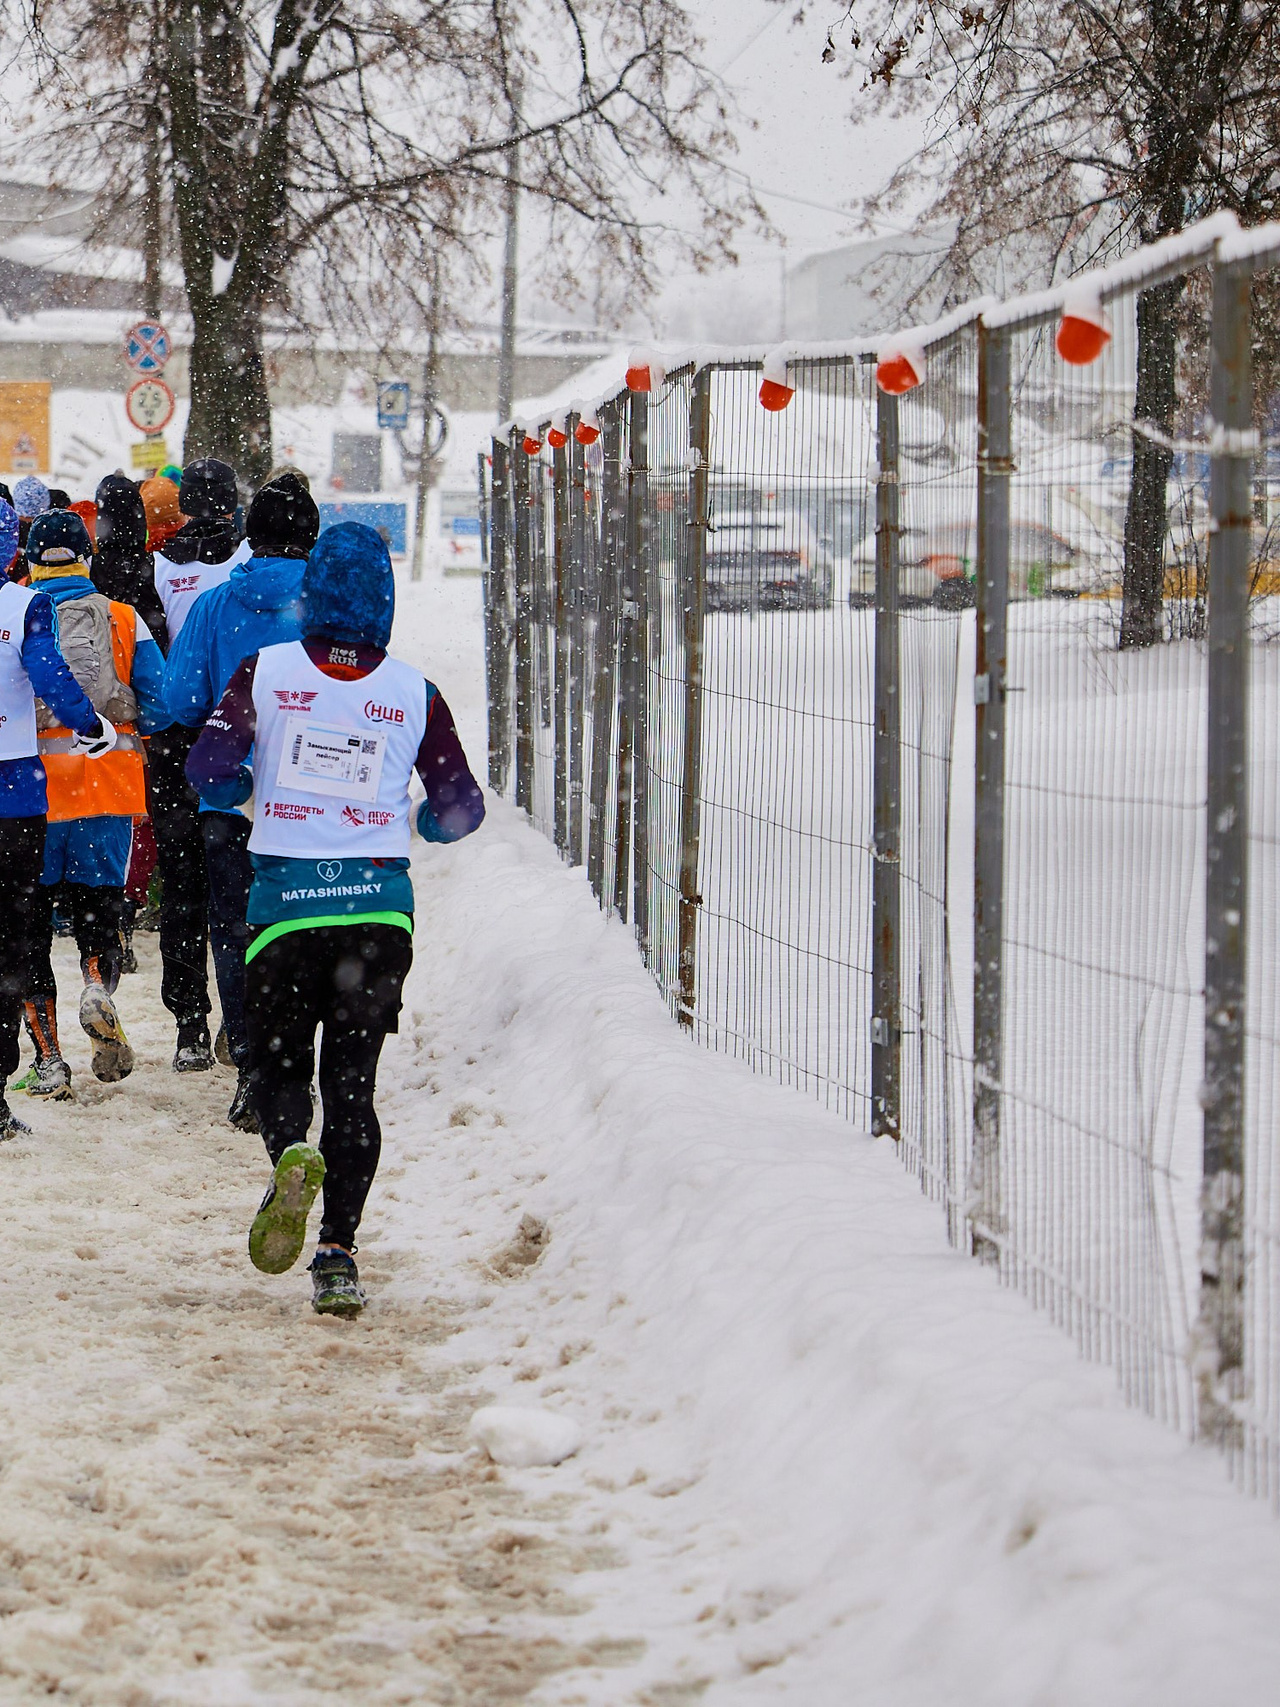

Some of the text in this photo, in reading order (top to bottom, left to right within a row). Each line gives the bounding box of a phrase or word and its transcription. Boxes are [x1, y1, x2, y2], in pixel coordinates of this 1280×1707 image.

[328, 654, 359, 668] RUN
[273, 803, 325, 815] ВЕРТОЛЕТЫ
[273, 811, 307, 821] РОССИИ
[281, 883, 382, 902] NATASHINSKY
